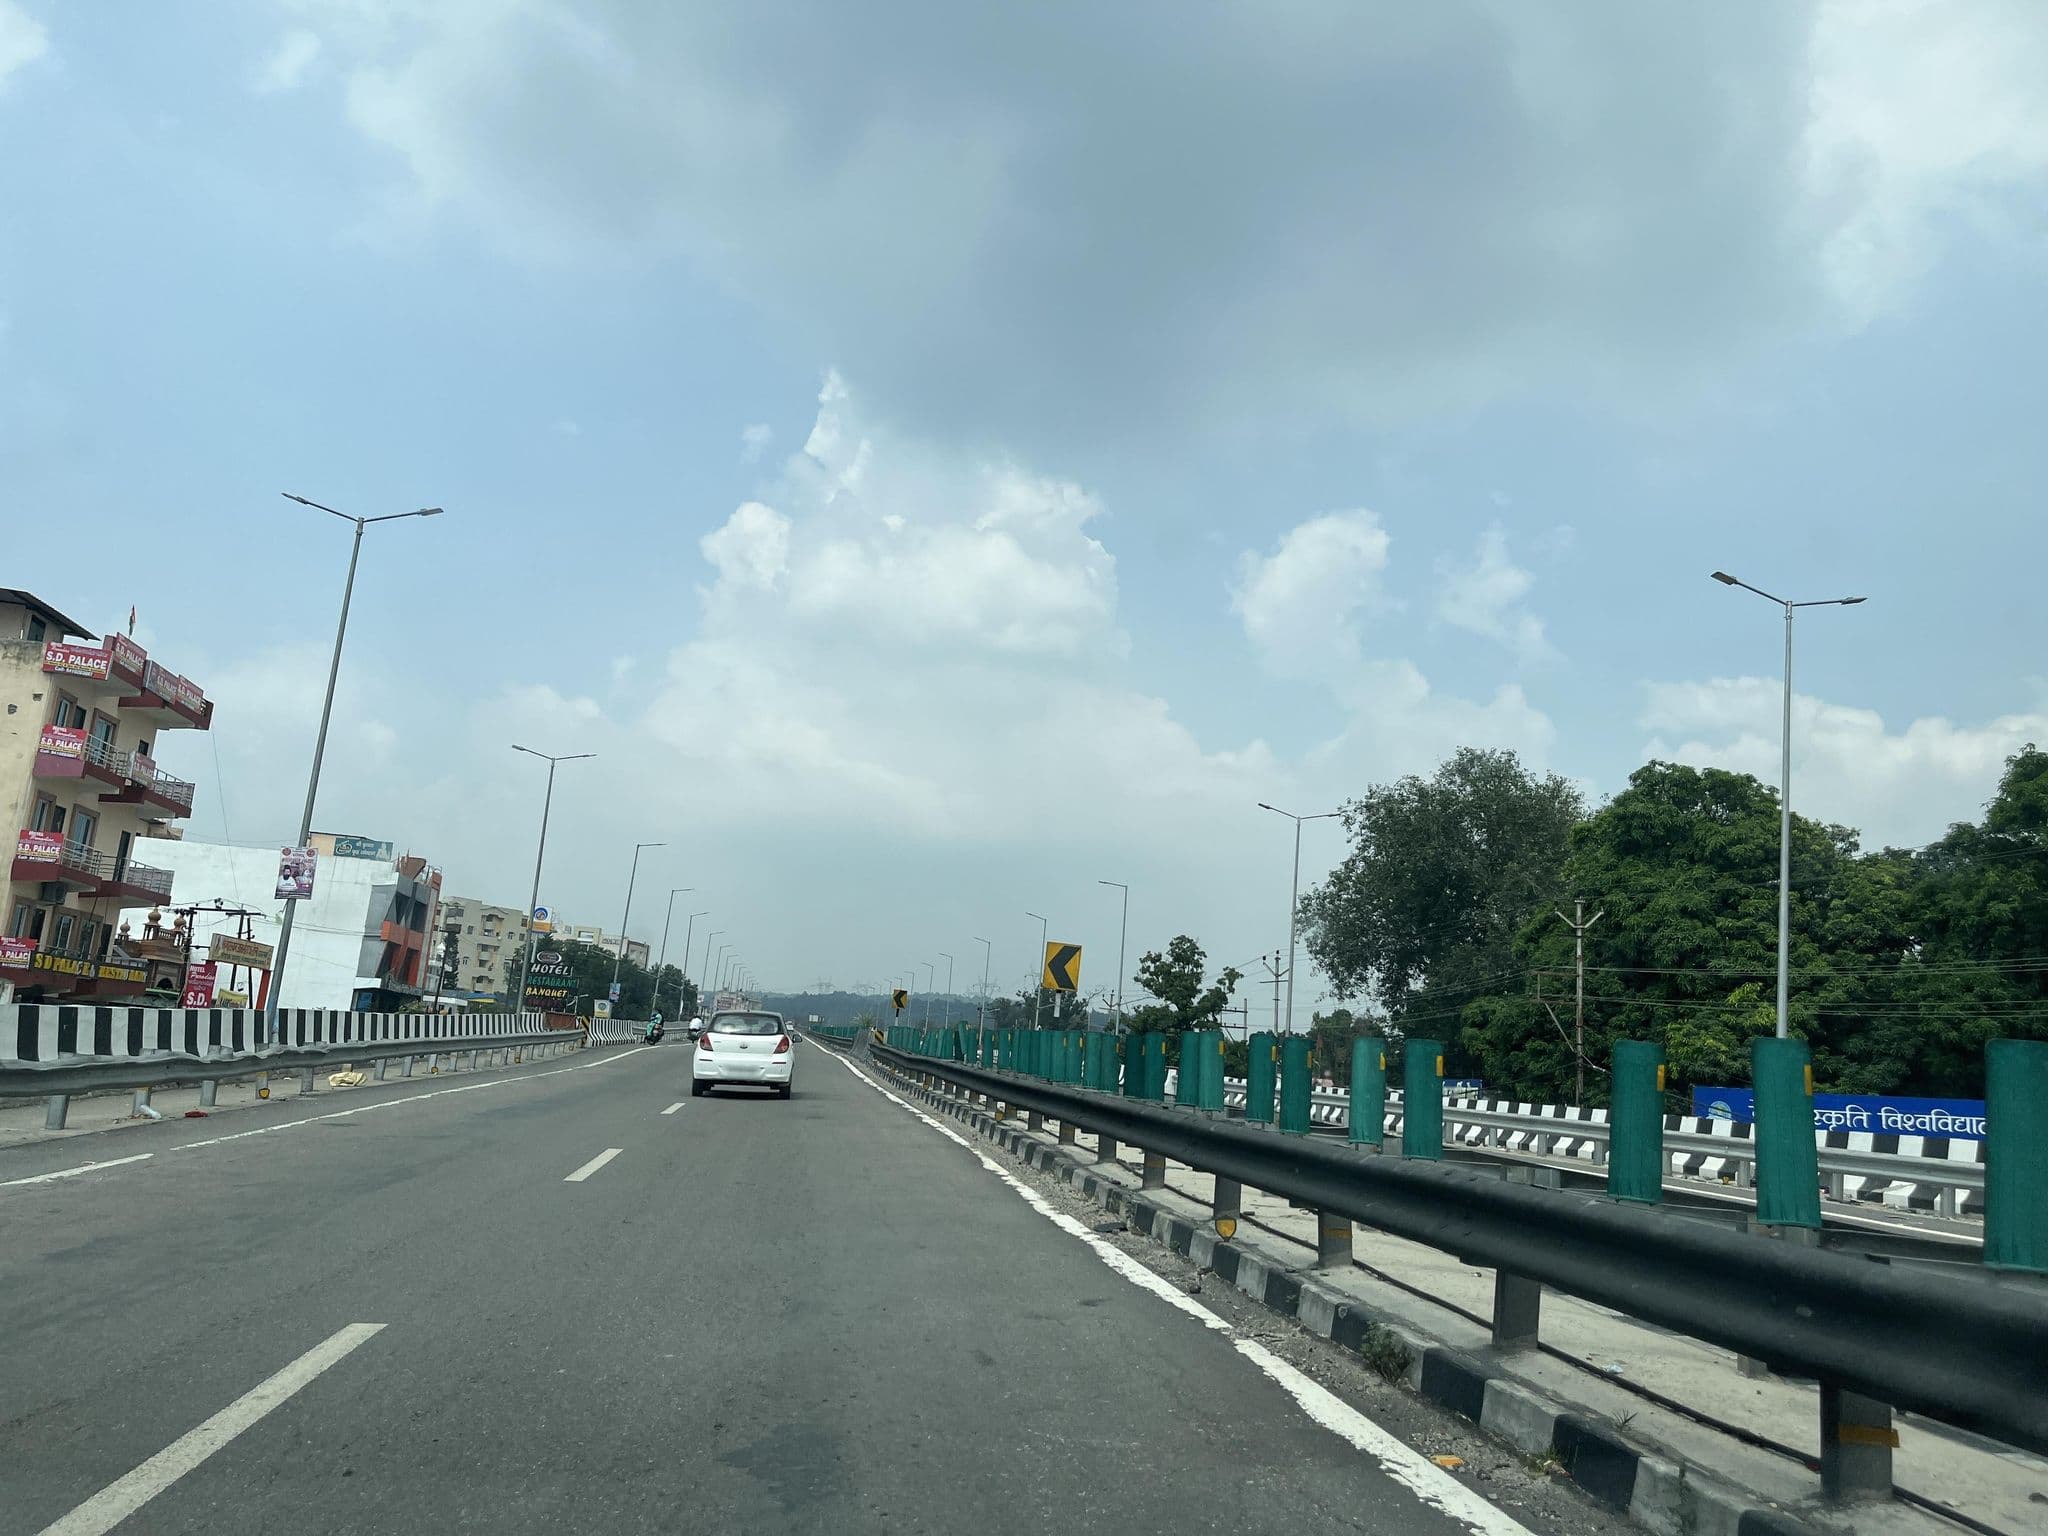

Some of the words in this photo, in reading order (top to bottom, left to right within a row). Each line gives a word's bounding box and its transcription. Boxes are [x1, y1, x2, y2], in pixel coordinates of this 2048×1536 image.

[46, 651, 65, 662] S.D.
[68, 654, 108, 670] PALACE
[40, 737, 54, 747] S.D.
[55, 739, 82, 751] PALACE
[18, 843, 31, 852] S.D.
[33, 844, 61, 854] PALACE
[530, 963, 569, 975] HOTEL
[186, 991, 208, 1006] S.D.
[525, 987, 568, 998] BANQUET
